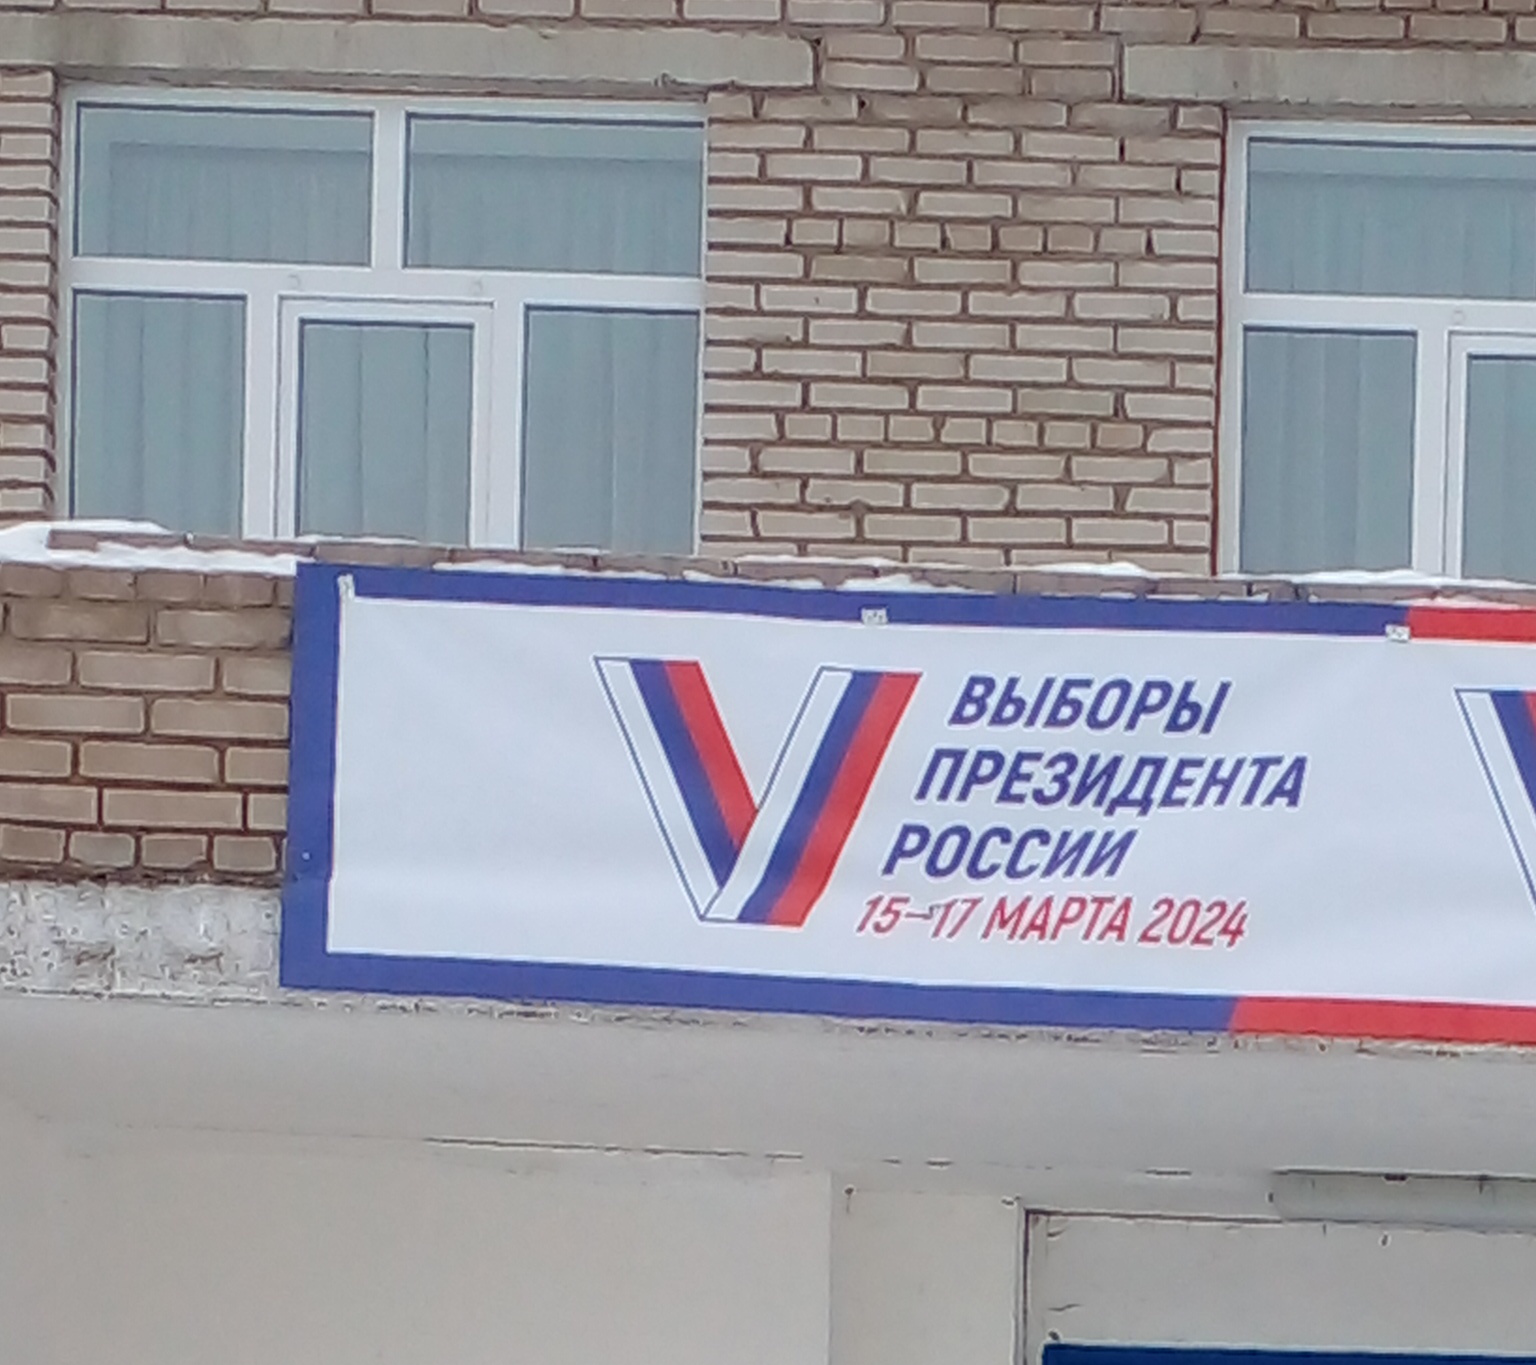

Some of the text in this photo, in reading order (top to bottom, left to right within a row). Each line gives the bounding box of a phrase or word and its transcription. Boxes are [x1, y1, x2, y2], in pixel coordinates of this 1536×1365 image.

[948, 674, 1230, 736] ВЫБОРЫ
[914, 749, 1307, 817] ПРЕЗИДЕНТА
[882, 824, 1137, 879] РОССИИ
[984, 896, 1129, 944] МАРТА
[1138, 899, 1249, 949] 2024
